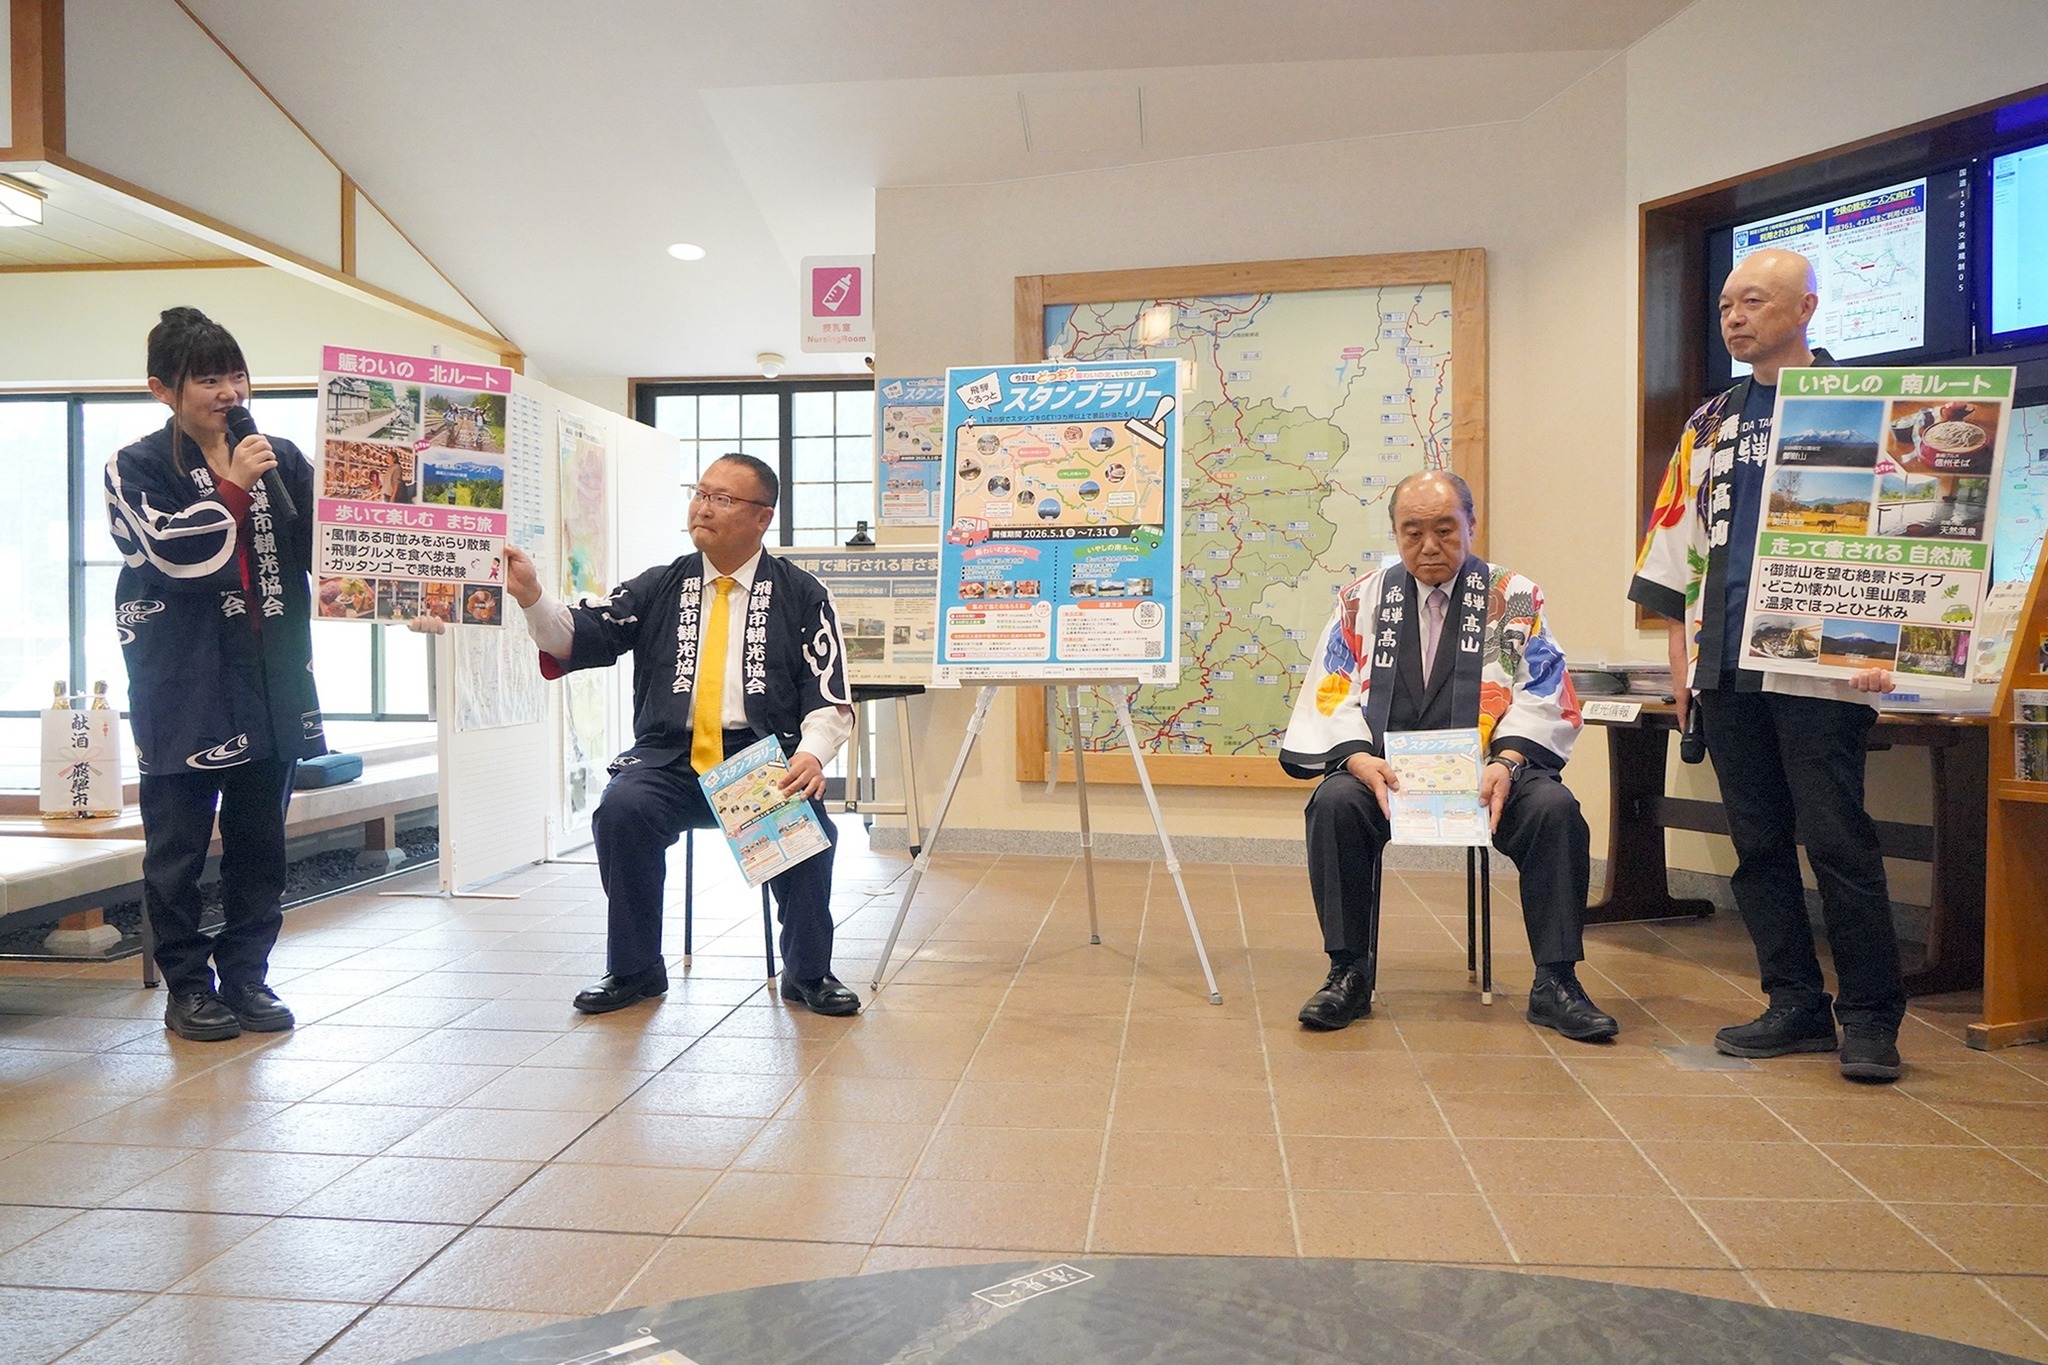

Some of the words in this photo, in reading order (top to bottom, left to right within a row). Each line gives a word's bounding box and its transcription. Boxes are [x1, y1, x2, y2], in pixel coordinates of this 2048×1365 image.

[822, 323, 851, 333] 授乳室
[337, 352, 415, 378] 賑わいの
[429, 364, 499, 389] 北ルート
[1798, 374, 1884, 394] いやしの
[1901, 374, 1992, 395] 南ルート
[965, 391, 998, 406] ぐるっと
[1003, 381, 1163, 413] スタンプラリー
[1740, 419, 1755, 433] DA
[1934, 458, 1972, 468] 信州そば
[335, 504, 434, 527] 歩いて楽しむ
[446, 513, 493, 533] まち旅
[1940, 526, 1977, 537] 天然温泉
[1770, 537, 1903, 563] 走って癒される
[1908, 544, 1973, 568] 自然旅
[672, 576, 702, 695] 飛騨市観光協会
[743, 580, 774, 696] 飛騨市観光協会
[71, 713, 91, 749] 献酒
